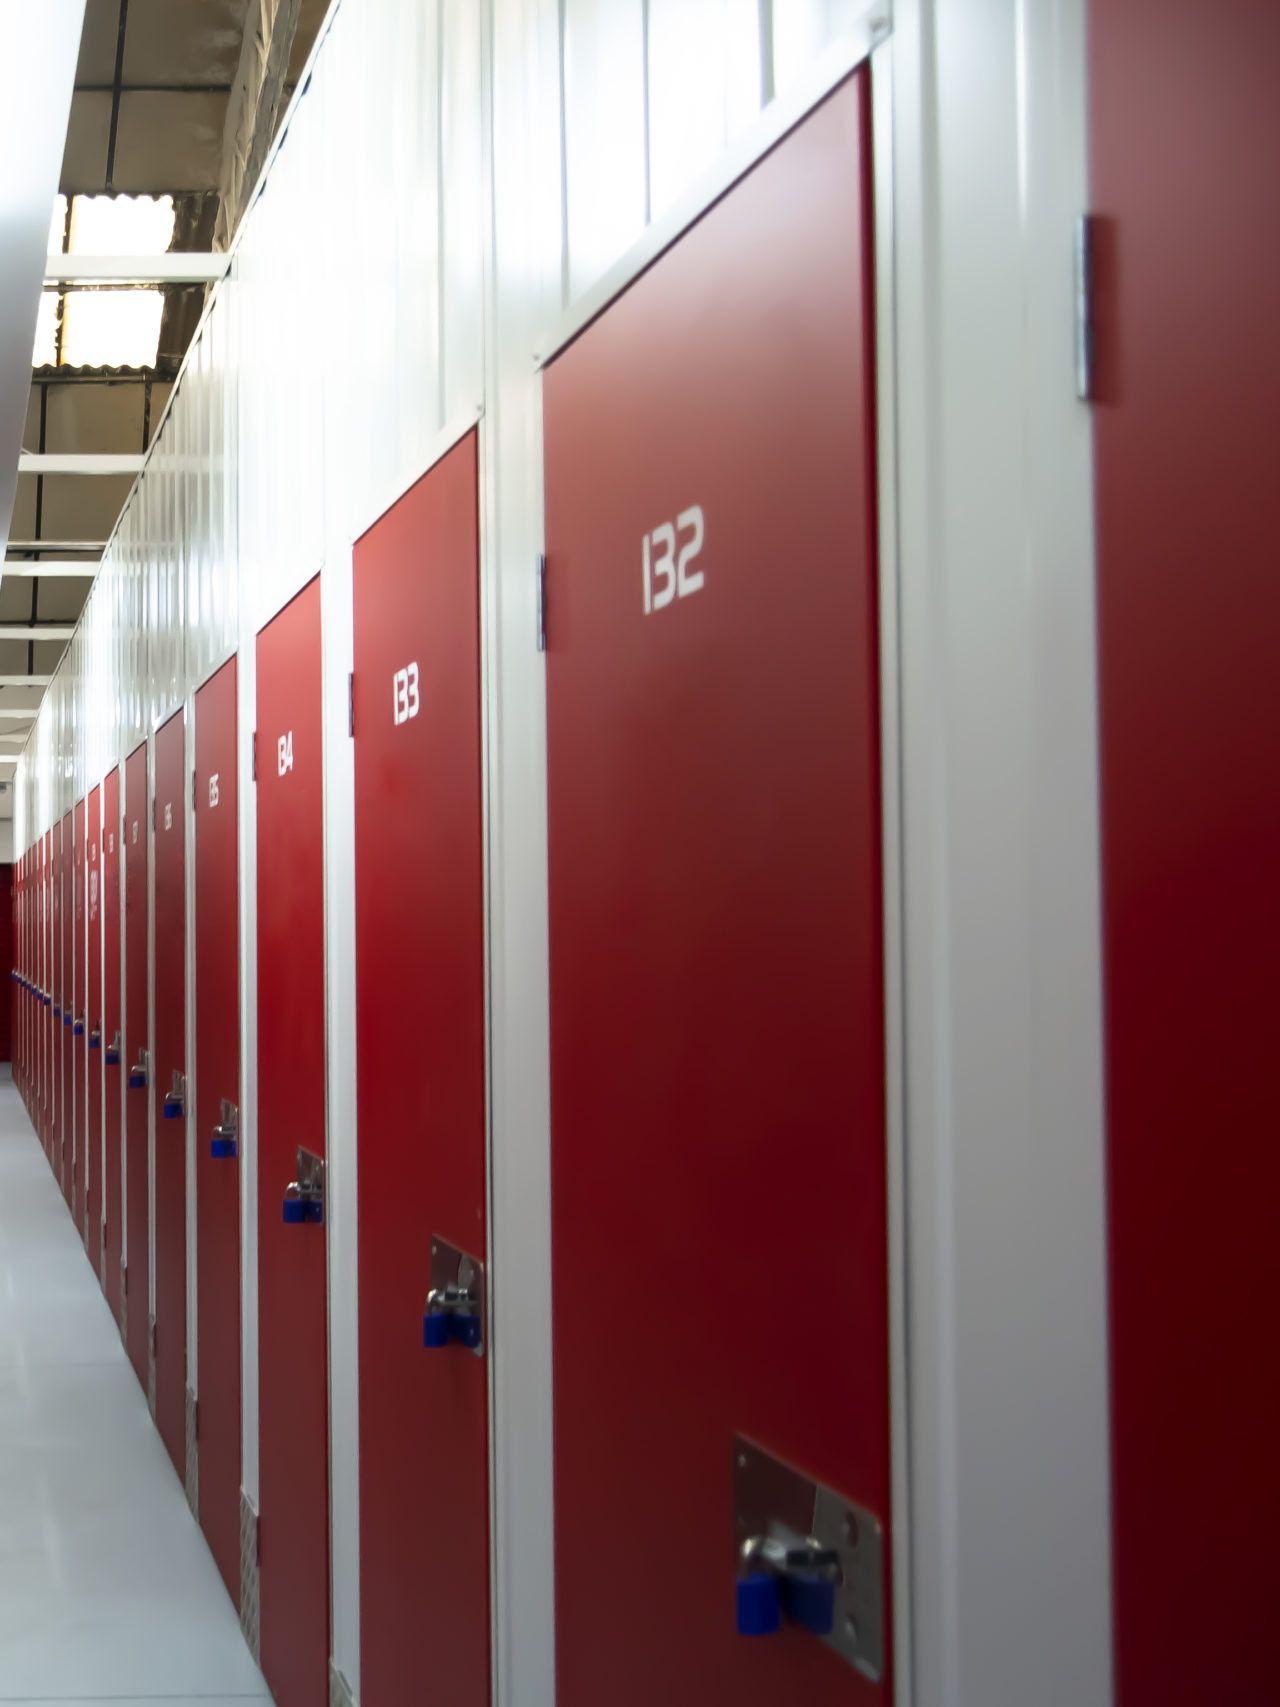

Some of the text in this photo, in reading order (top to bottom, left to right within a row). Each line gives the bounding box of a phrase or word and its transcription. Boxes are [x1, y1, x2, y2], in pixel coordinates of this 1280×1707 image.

[642, 506, 706, 616] 132
[393, 661, 420, 727] 133
[277, 731, 294, 777] 134
